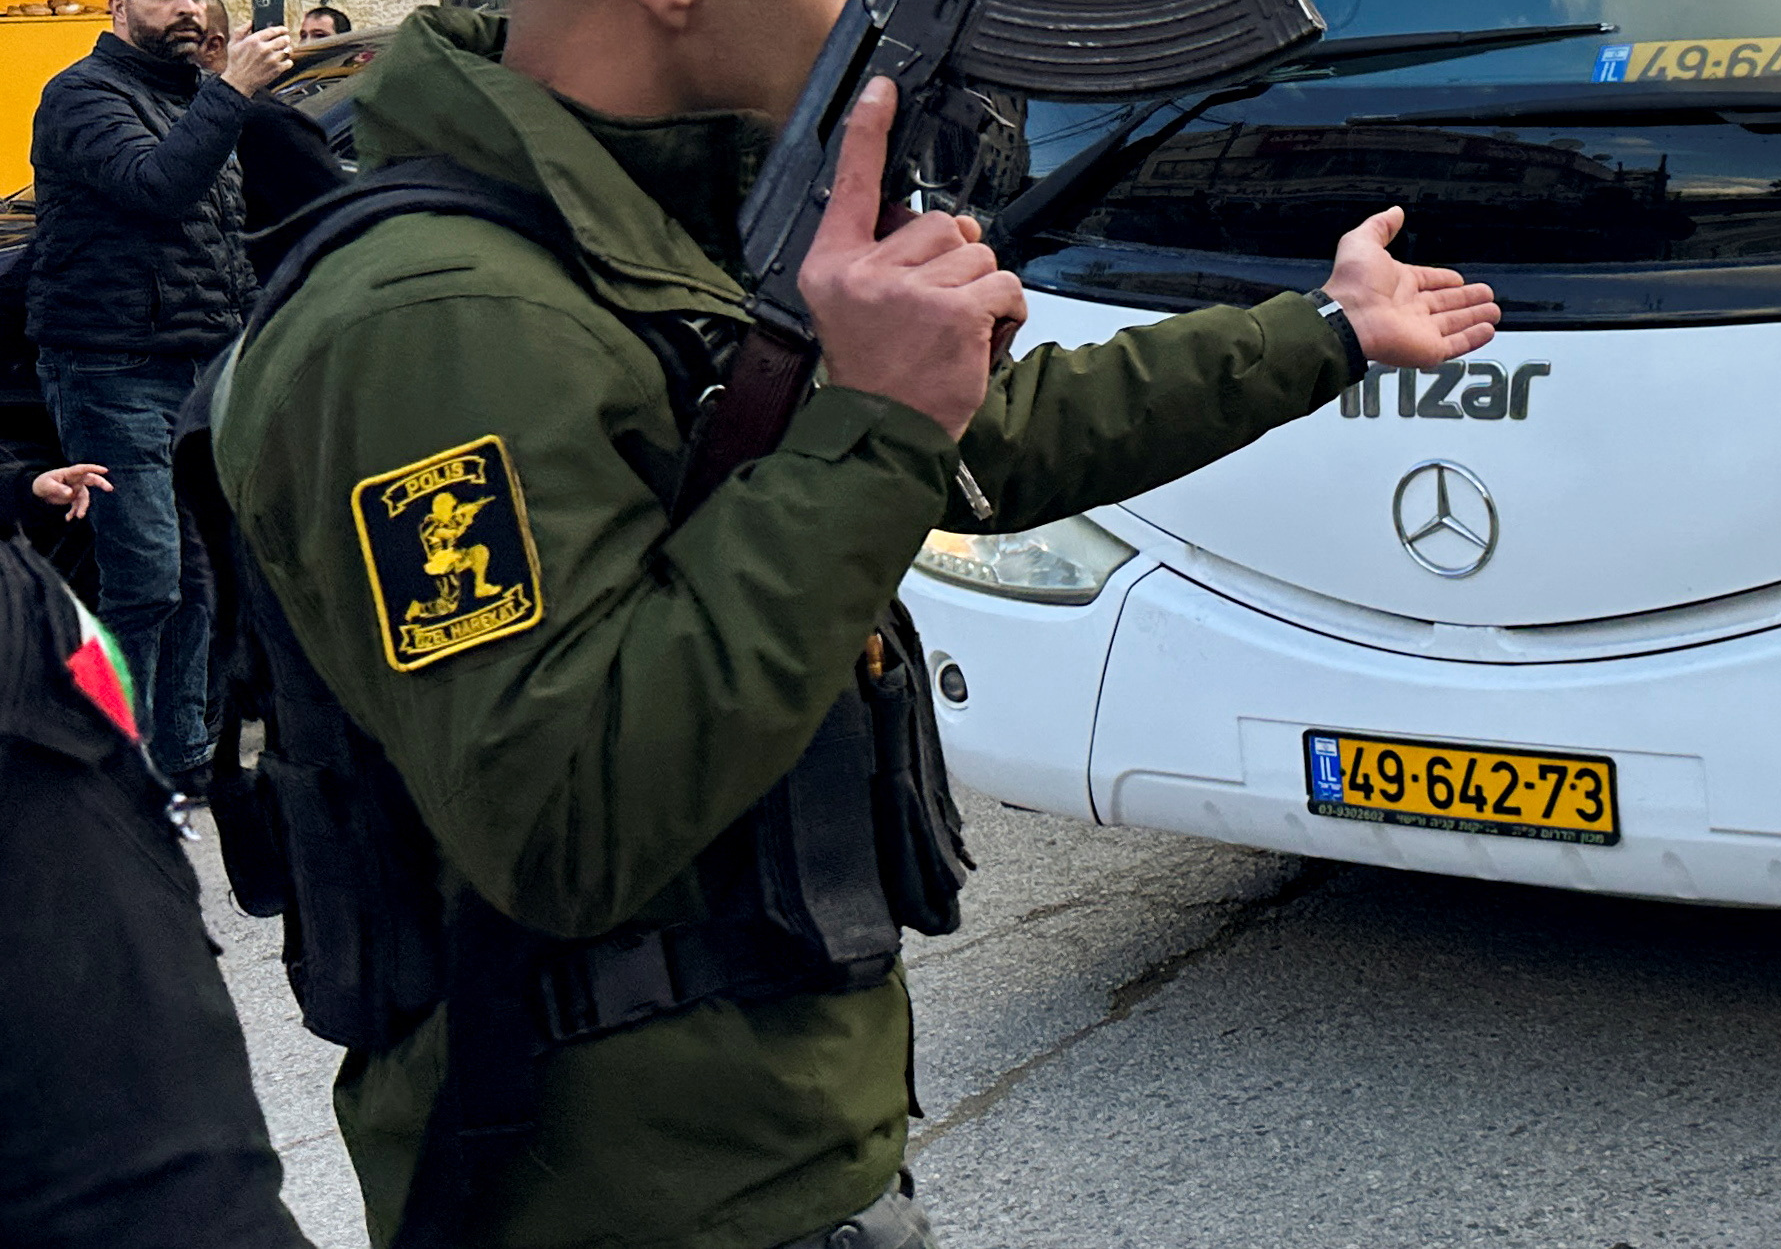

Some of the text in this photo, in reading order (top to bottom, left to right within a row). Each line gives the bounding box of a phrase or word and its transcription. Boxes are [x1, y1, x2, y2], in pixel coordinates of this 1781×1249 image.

[450, 601, 517, 640] HAREKAT
[1319, 755, 1337, 782] IL
[1318, 803, 1385, 822] 03-9302602
